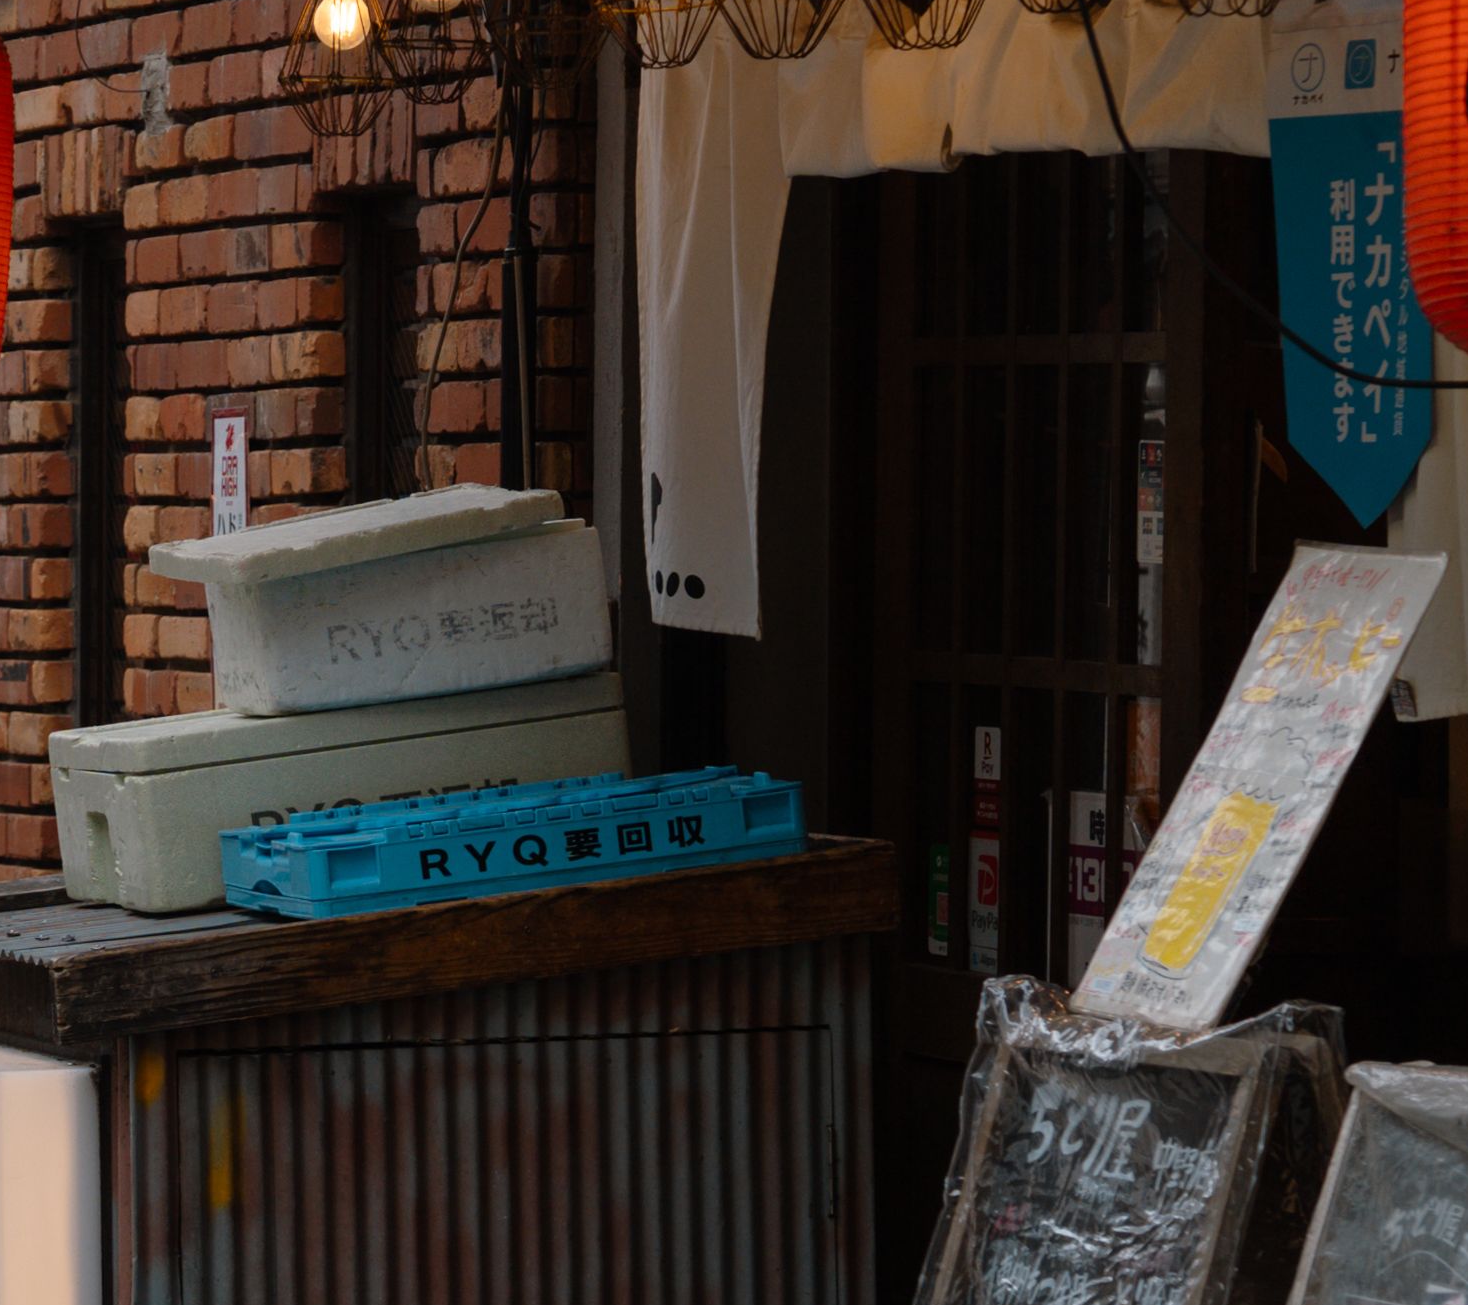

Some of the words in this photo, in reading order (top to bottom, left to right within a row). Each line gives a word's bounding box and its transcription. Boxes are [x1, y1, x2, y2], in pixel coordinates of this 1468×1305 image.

[1329, 179, 1356, 444] 利用できます
[325, 596, 562, 665] RYQ要返却
[419, 813, 707, 881] RYQ要回収
[972, 909, 998, 932] PayPa
